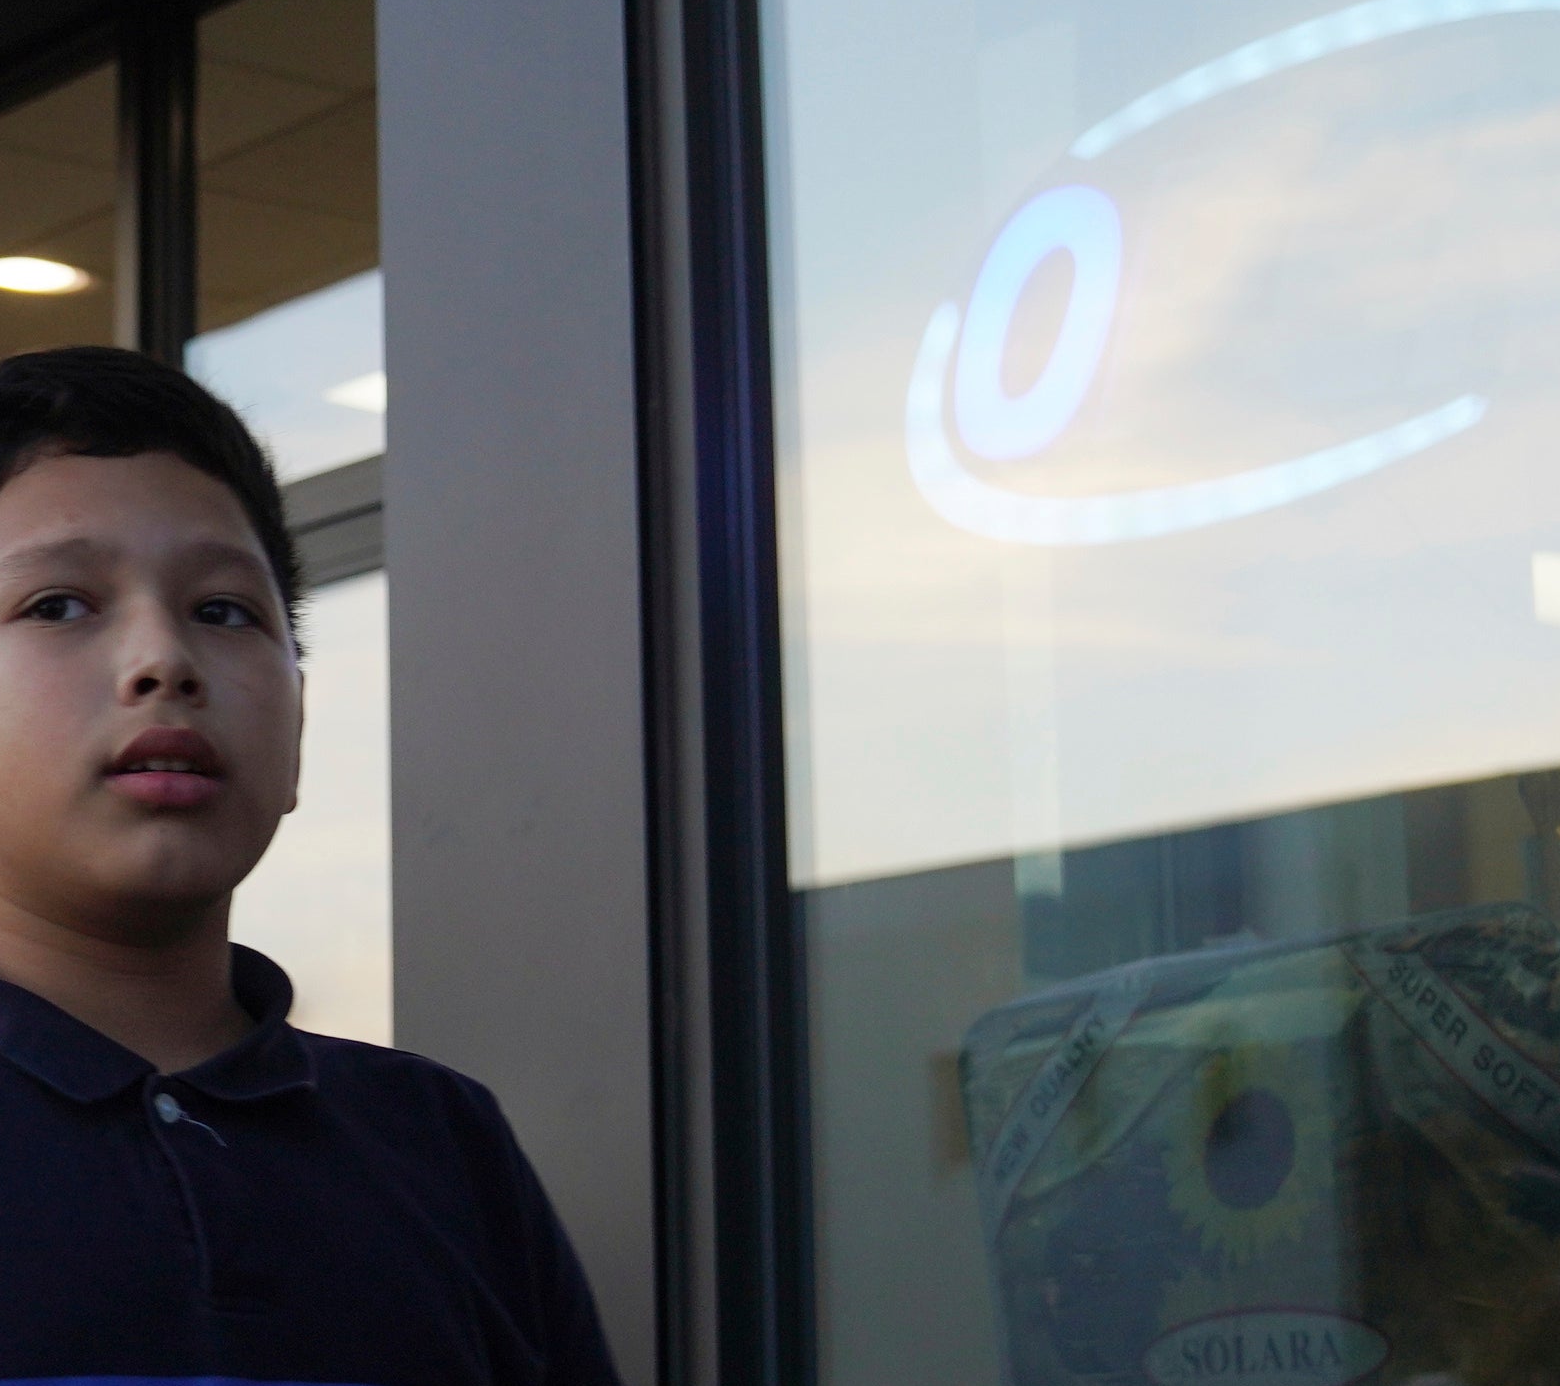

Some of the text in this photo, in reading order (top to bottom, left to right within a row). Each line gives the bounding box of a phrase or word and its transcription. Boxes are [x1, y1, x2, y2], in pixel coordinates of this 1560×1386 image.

[1387, 960, 1556, 1114] SUPER SOFT
[1180, 1328, 1343, 1375] SOLARA
